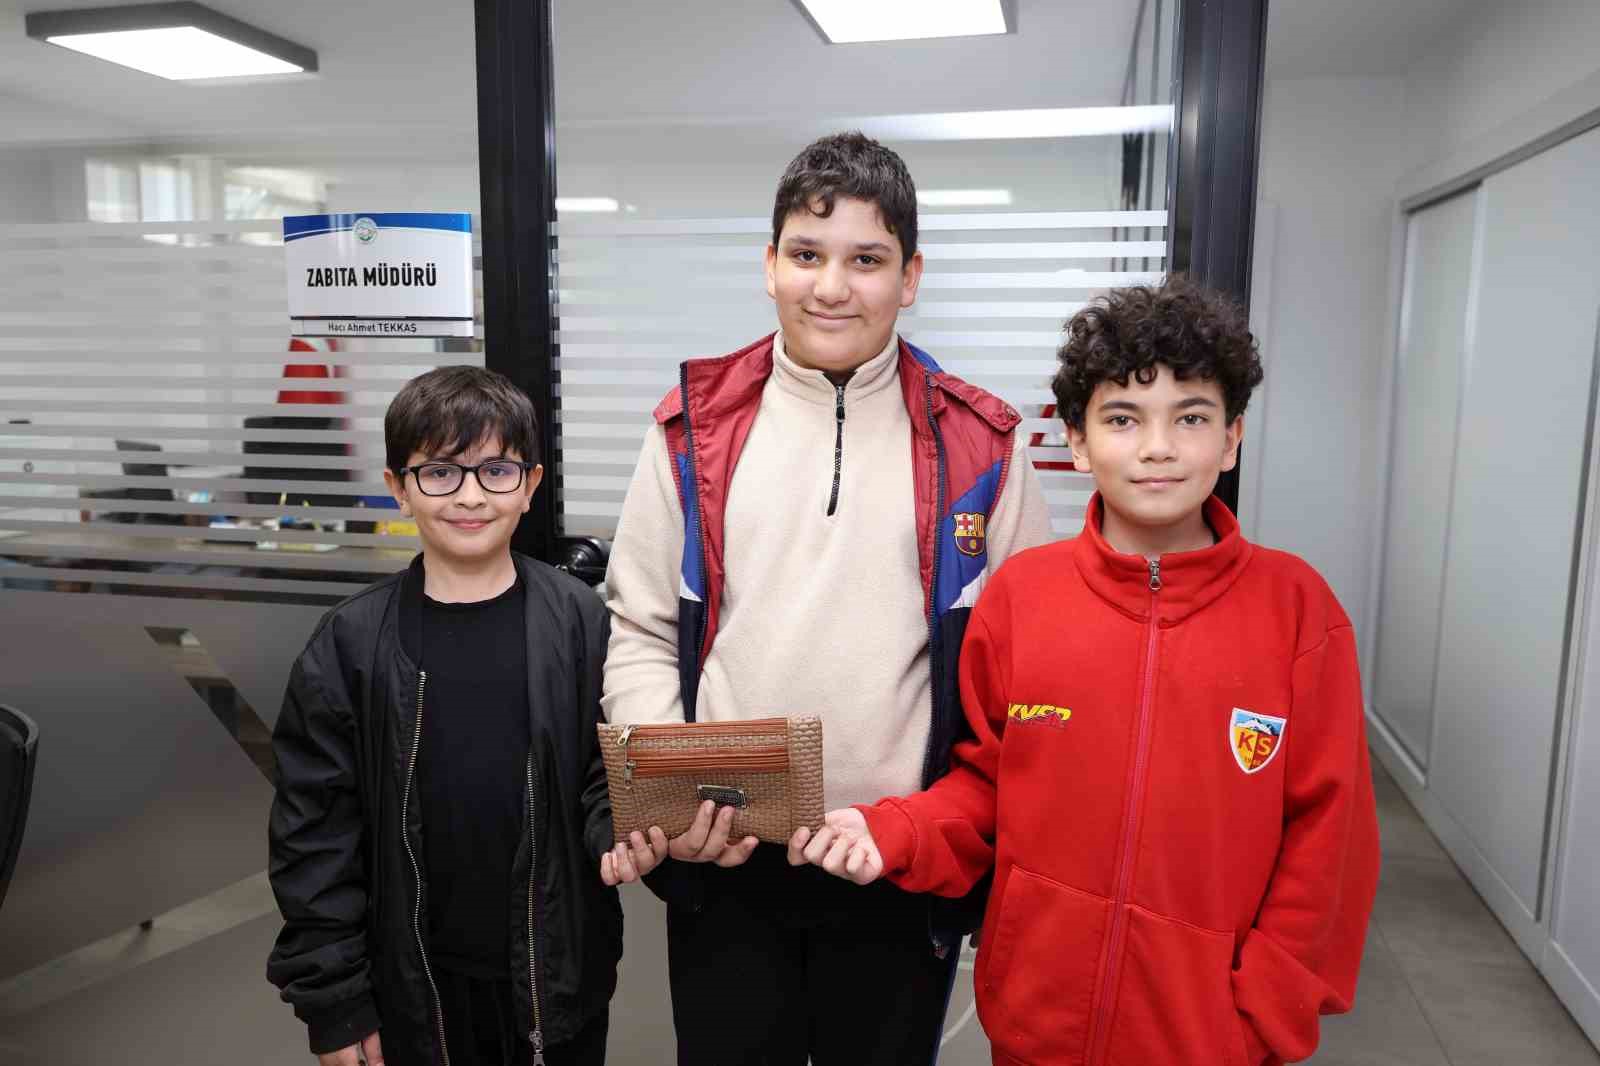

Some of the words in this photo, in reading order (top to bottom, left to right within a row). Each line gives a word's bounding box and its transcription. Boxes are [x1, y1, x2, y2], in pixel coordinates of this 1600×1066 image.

[307, 268, 358, 287] ZABITA
[363, 263, 437, 287] MÜDÜRÜ
[347, 322, 376, 332] Ahmet
